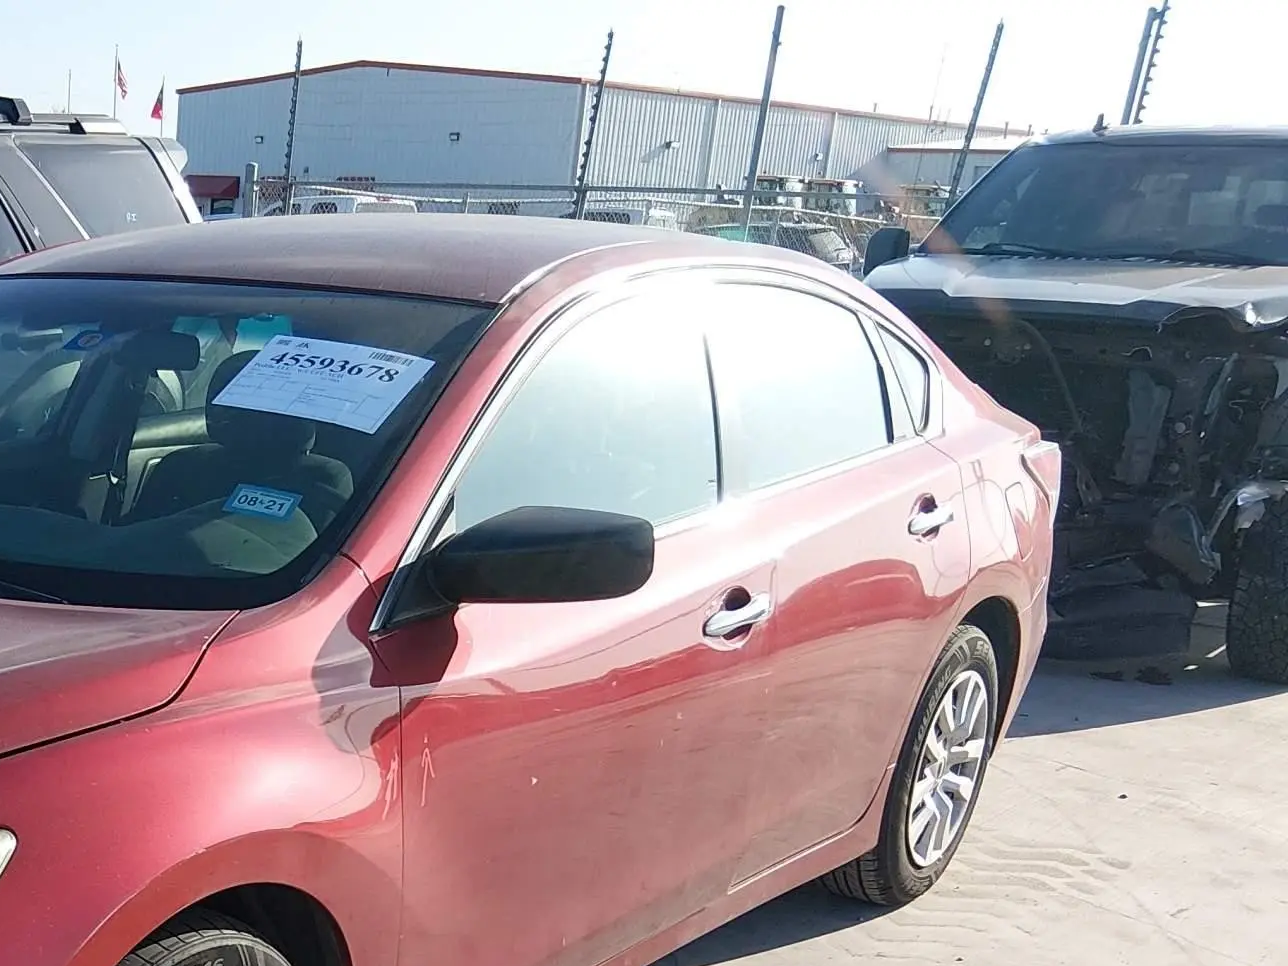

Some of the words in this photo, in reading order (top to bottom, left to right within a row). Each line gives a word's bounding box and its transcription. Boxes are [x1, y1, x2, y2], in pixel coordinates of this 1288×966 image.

[270, 352, 399, 383] 45593678
[237, 494, 259, 507] 08
[264, 500, 286, 512] 21
